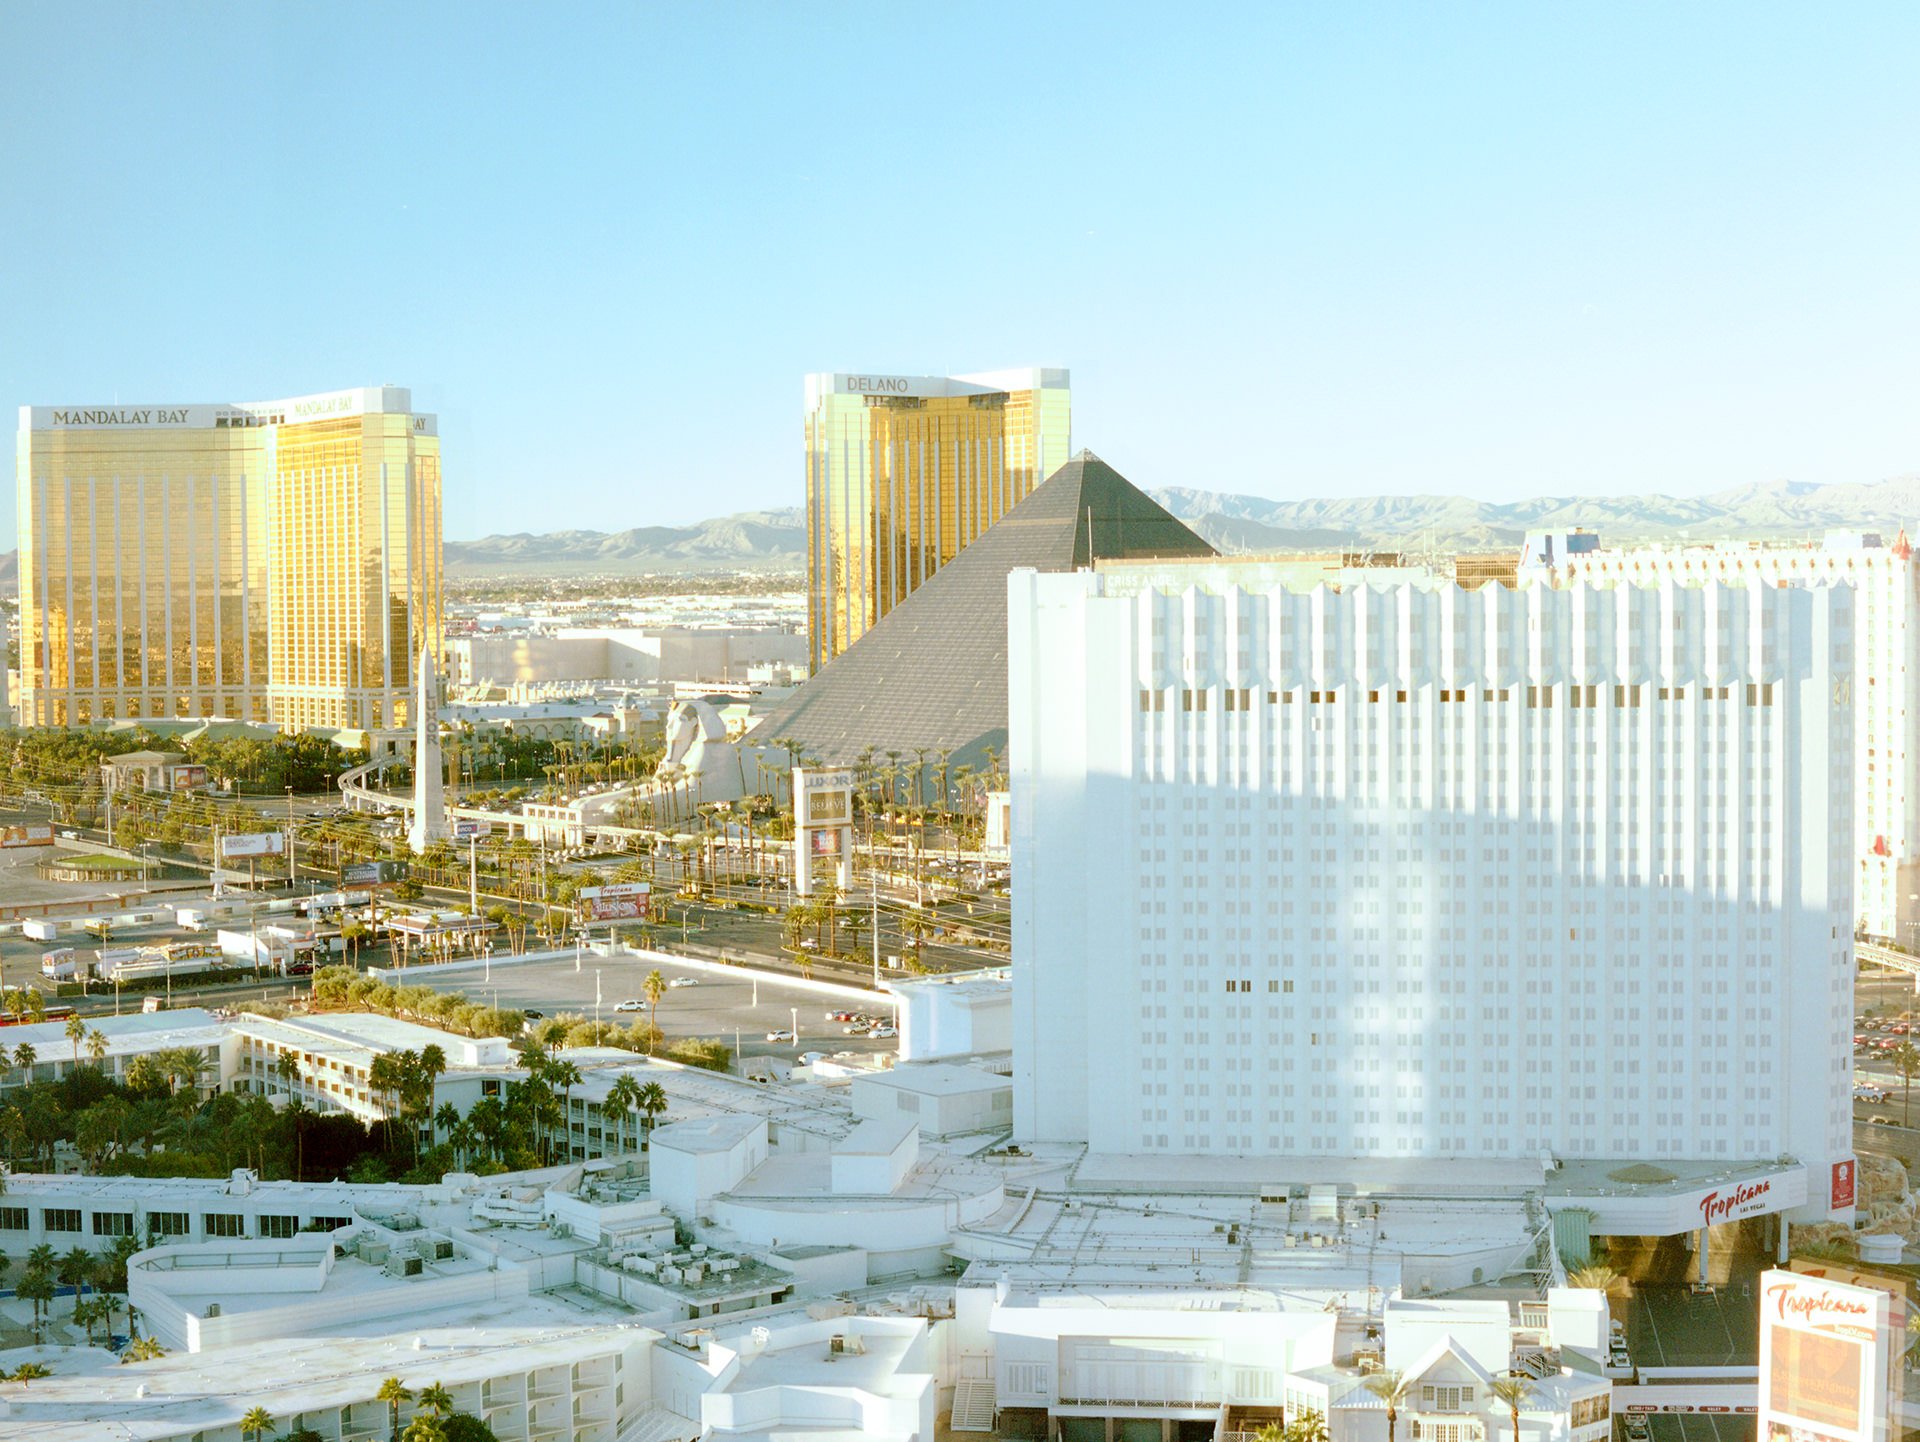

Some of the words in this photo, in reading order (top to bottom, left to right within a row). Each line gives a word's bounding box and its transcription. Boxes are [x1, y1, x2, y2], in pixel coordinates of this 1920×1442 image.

[847, 377, 908, 392] DELANO
[294, 398, 336, 416] MANDALAY
[338, 395, 353, 411] BAY
[53, 410, 152, 424] MANDALAY
[157, 409, 189, 423] BAY
[412, 417, 427, 431] AY
[425, 689, 439, 745] LUXOR
[804, 775, 850, 787] LUXOR
[811, 801, 845, 812] BELIEVE
[599, 885, 632, 896] Tropicana
[1700, 1181, 1771, 1227] Tropicana
[1750, 1202, 1766, 1211] VEGAS
[1767, 1283, 1869, 1321] Tropicana
